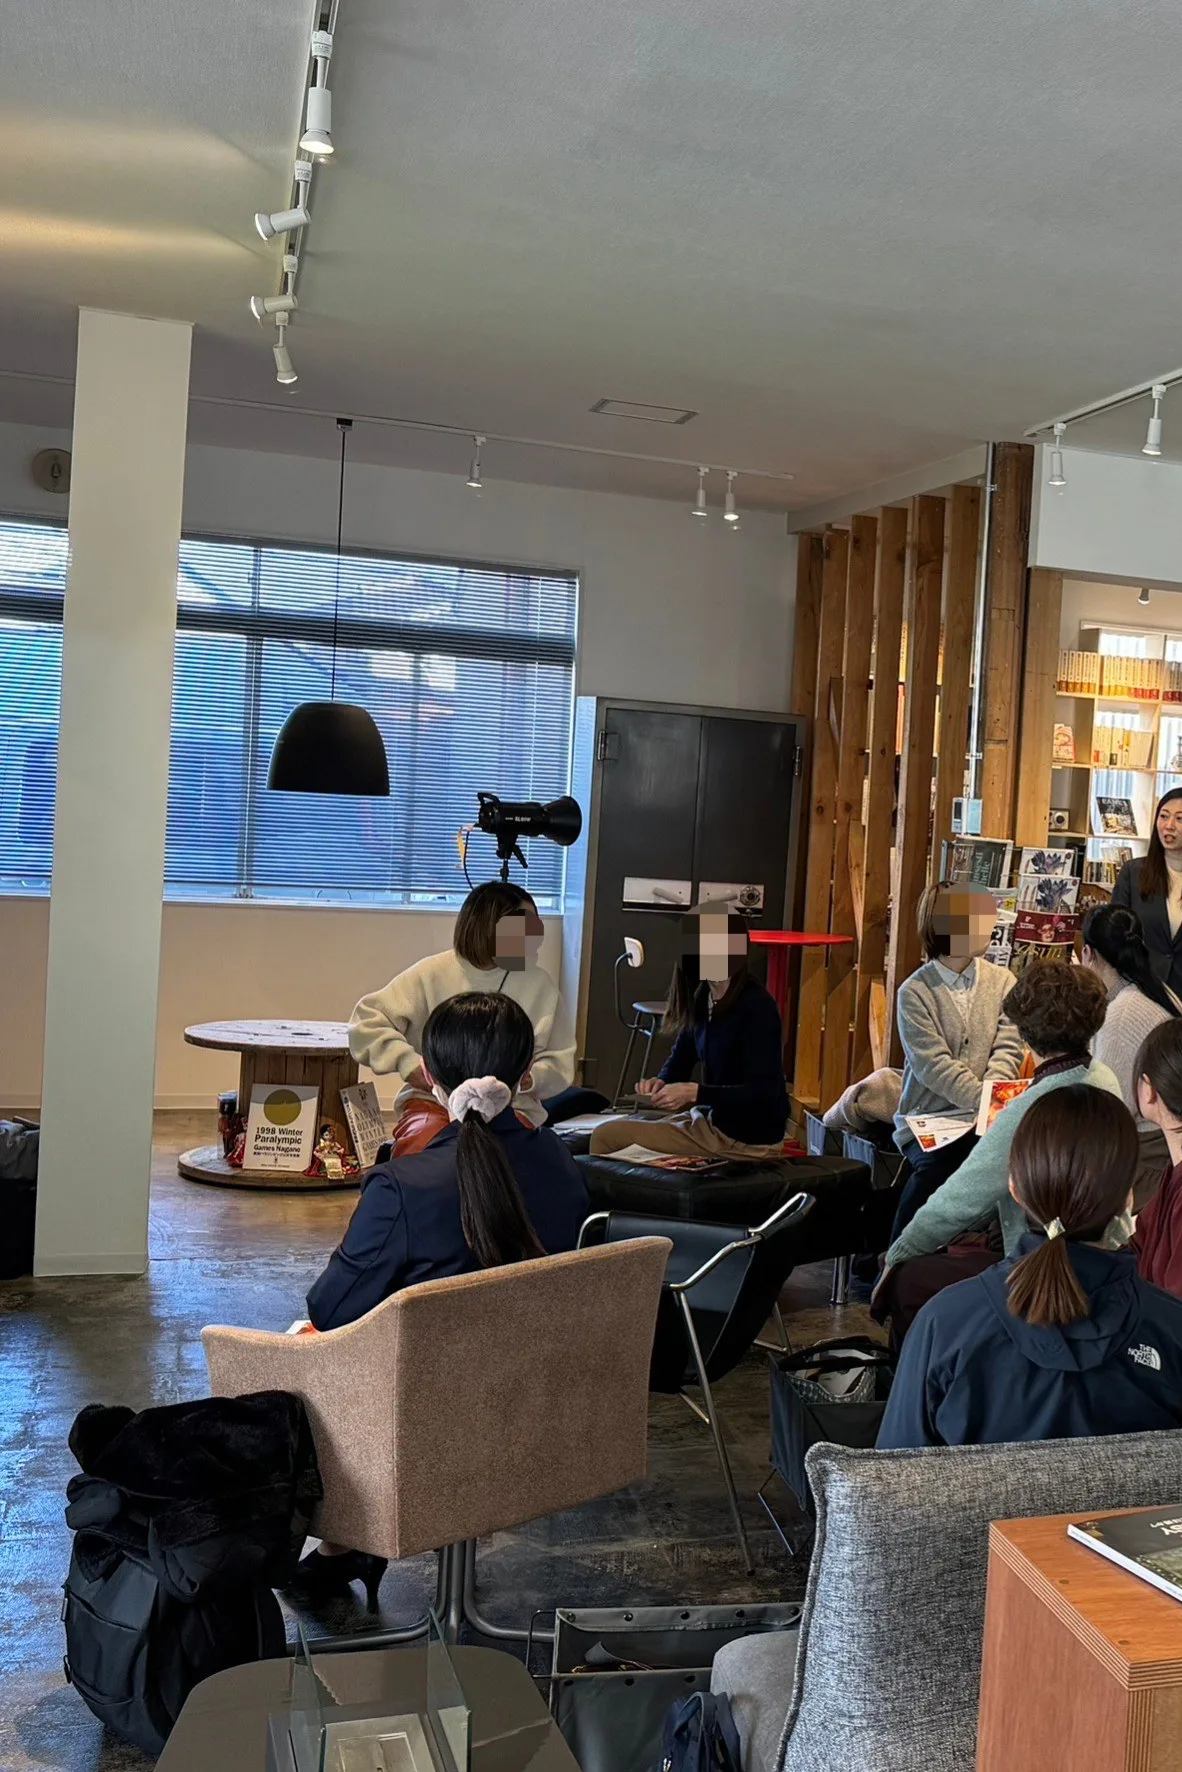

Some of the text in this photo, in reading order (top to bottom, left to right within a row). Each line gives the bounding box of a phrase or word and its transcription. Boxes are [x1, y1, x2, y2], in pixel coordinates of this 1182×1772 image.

[256, 1126, 303, 1136] 1998 Winter
[254, 1134, 302, 1146] Paralympic
[253, 1143, 301, 1153] Games Nagano
[1127, 1347, 1152, 1360] NORTH
[1139, 1343, 1152, 1353] THE
[1134, 1354, 1152, 1367] FACE
